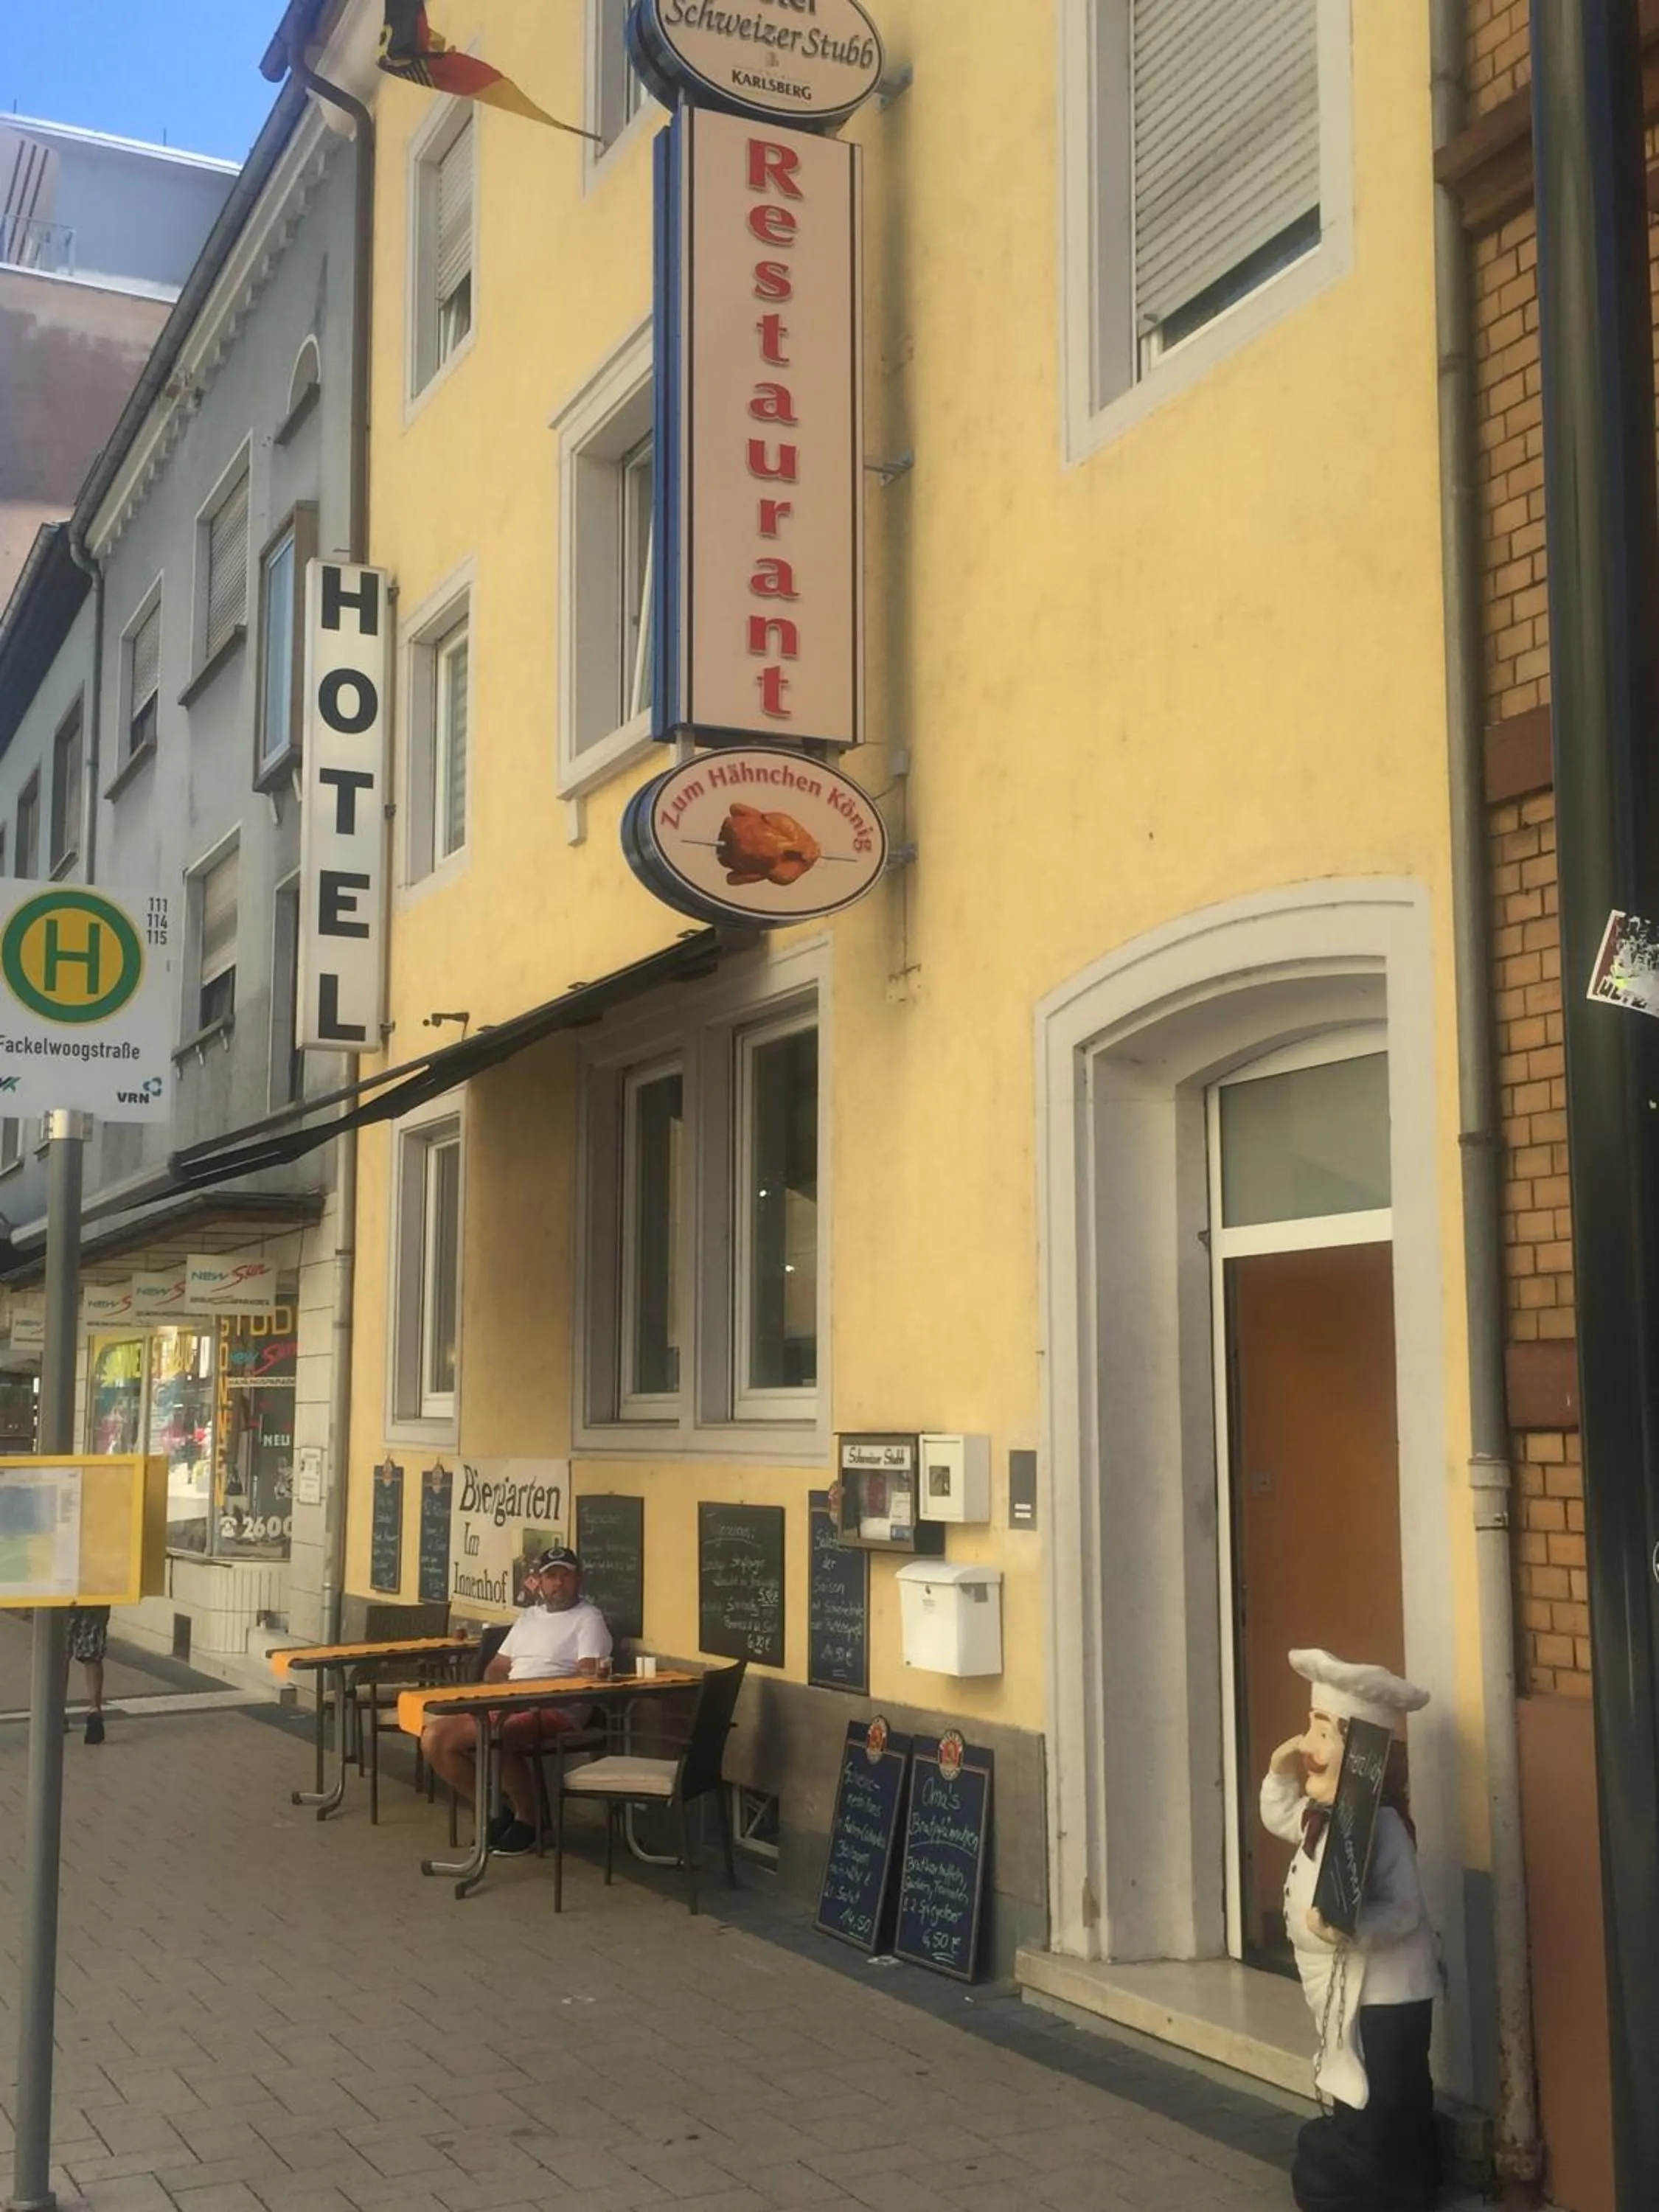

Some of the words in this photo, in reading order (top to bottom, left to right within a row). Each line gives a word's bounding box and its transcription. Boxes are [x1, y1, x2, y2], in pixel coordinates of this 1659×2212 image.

[731, 69, 812, 100] KARLSBERG
[745, 137, 804, 720] Restaurant
[318, 566, 378, 1042] HOTEL
[661, 781, 705, 830] Zum
[708, 761, 823, 797] Hähnchen
[826, 787, 875, 853] König
[147, 914, 168, 929] 114
[149, 897, 168, 913] 111
[147, 930, 167, 945] 115
[116, 1092, 150, 1104] VRN
[263, 1434, 291, 1447] NEU
[459, 1464, 561, 1526] Biergarten
[464, 1522, 480, 1557] Im
[453, 1562, 509, 1604] Innenhof
